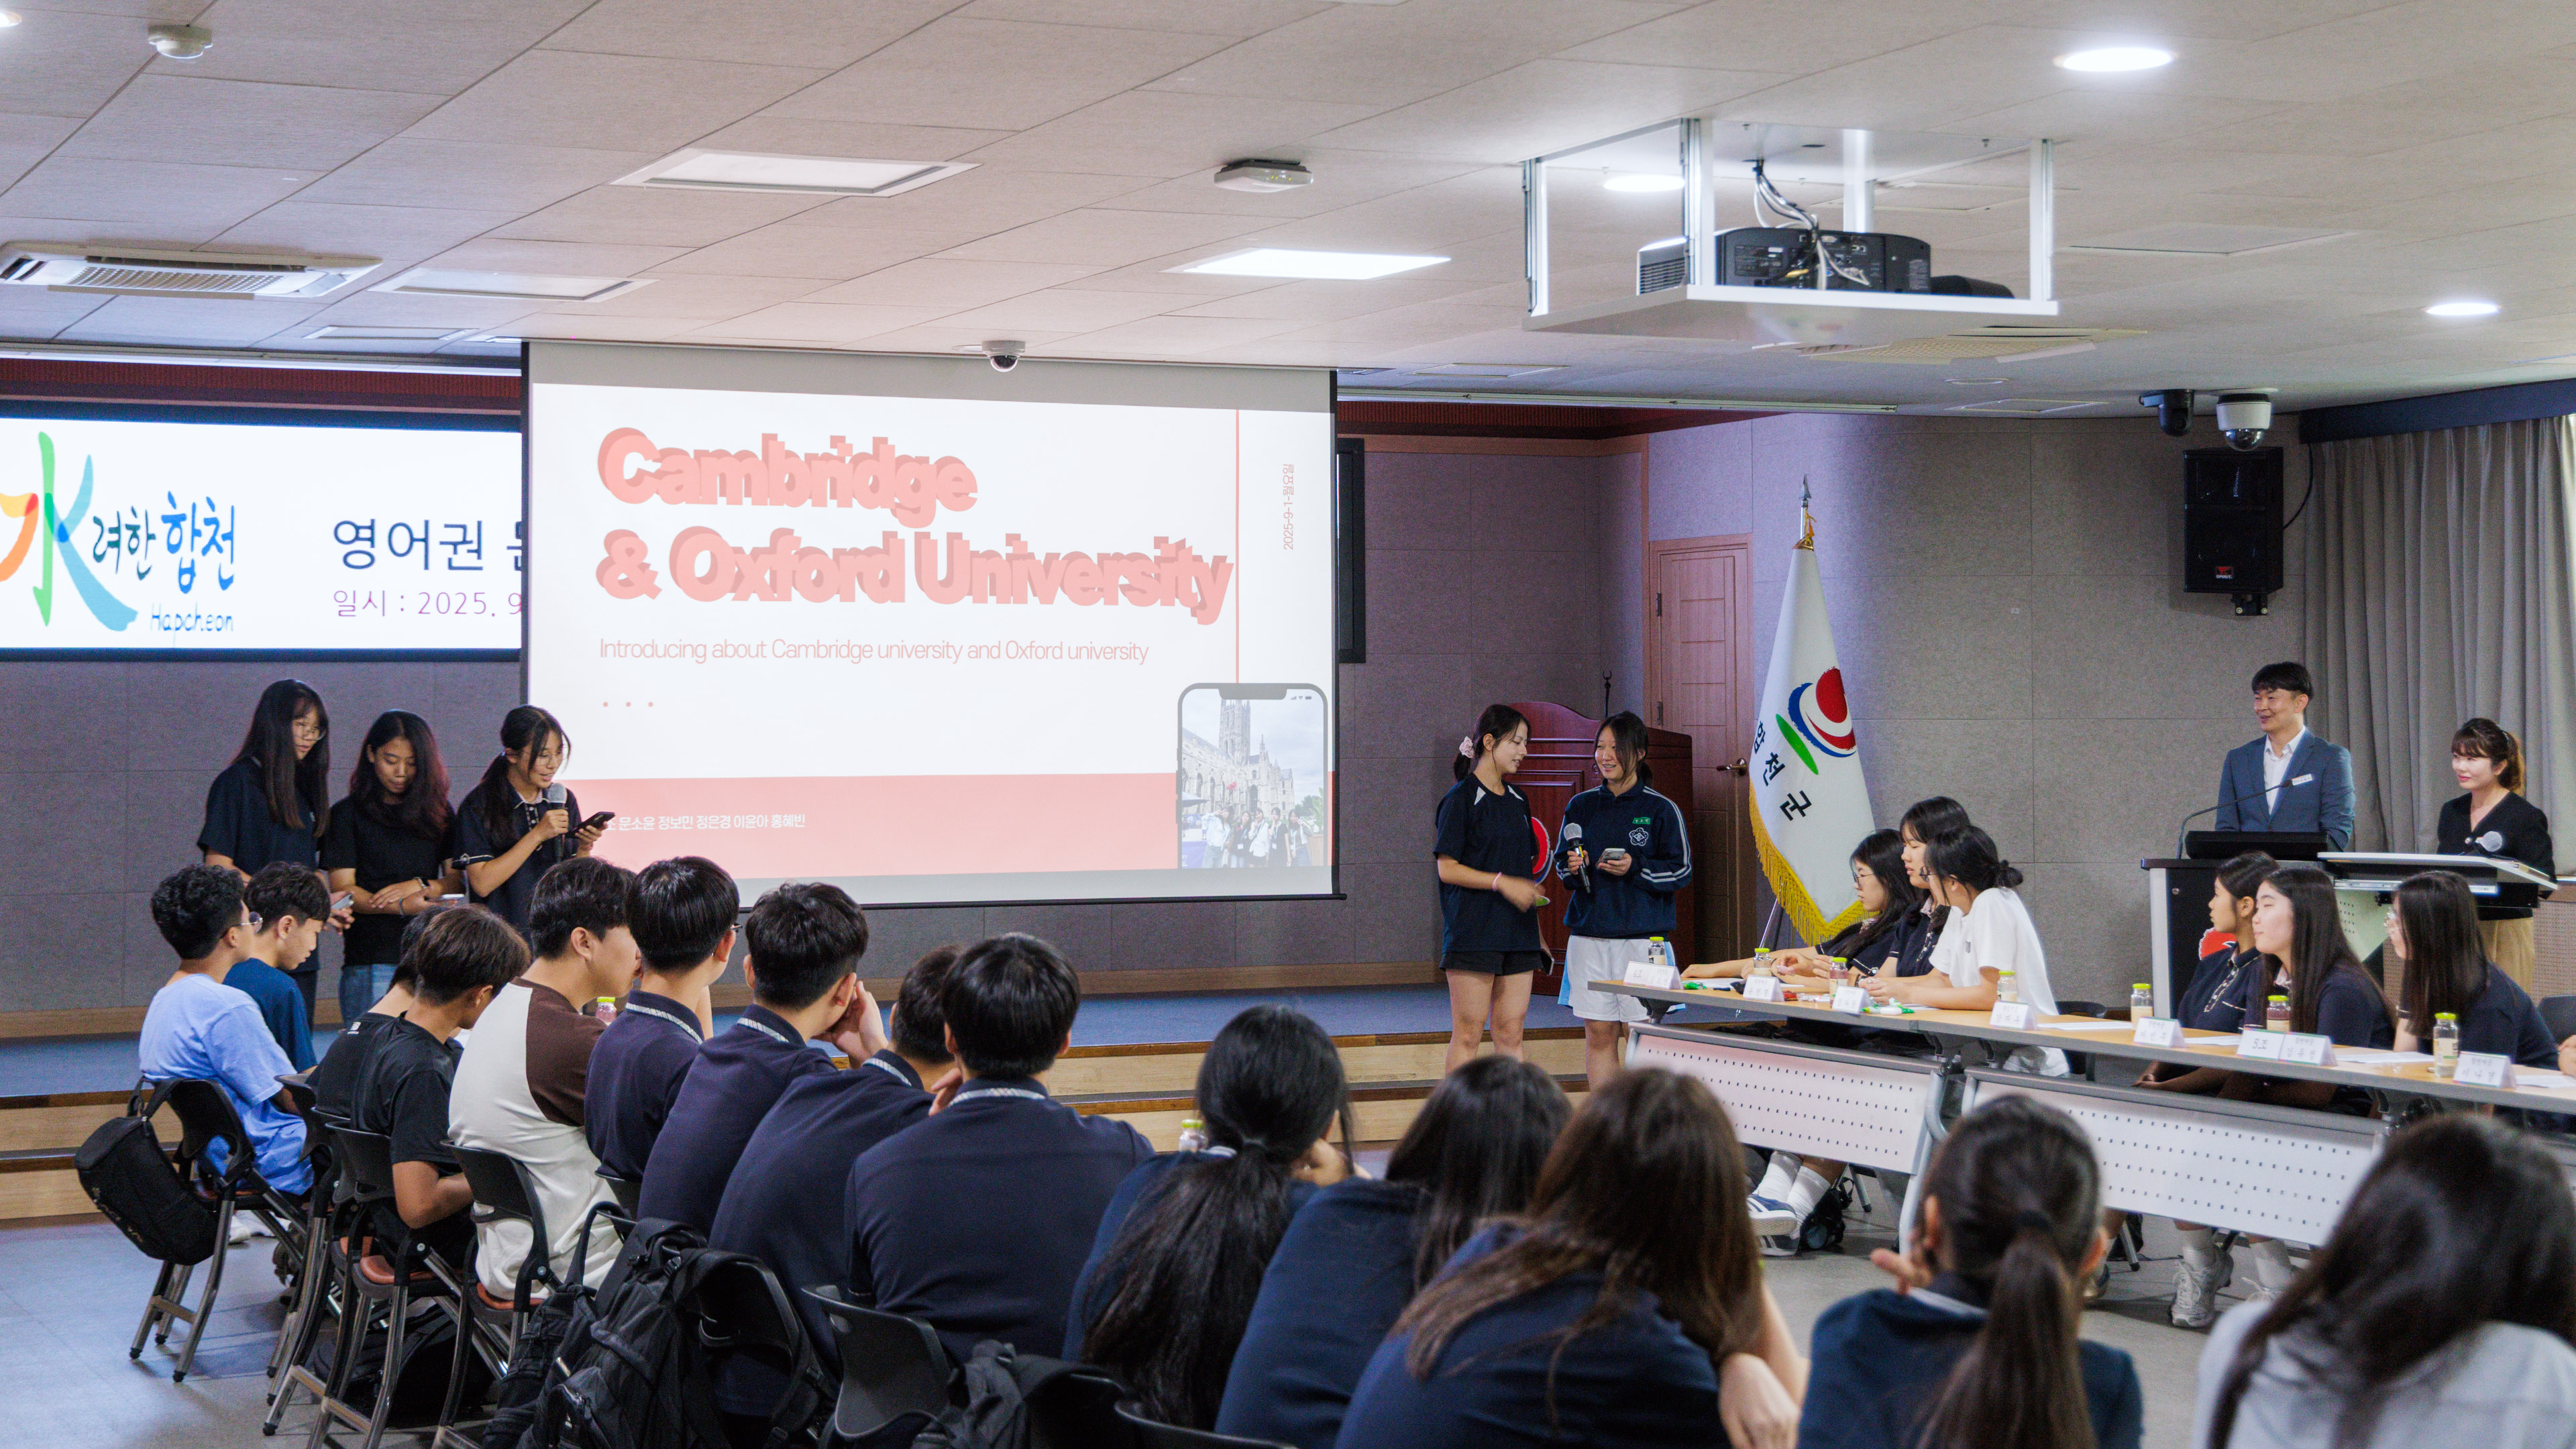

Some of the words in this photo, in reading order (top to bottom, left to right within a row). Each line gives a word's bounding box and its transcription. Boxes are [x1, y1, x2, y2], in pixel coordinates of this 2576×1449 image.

[598, 427, 977, 528] Cambridge
[161, 490, 234, 594] 합천
[333, 519, 483, 570] 영어권
[596, 529, 663, 600] &
[669, 526, 906, 604] Oxford
[914, 532, 1234, 626] University
[150, 602, 233, 643] Hapcheon
[333, 590, 385, 616] 일시
[418, 592, 495, 617] 2025.
[600, 639, 707, 664] Introducing
[712, 639, 767, 658] about
[772, 639, 873, 664] Cambridge
[877, 640, 963, 664] university
[967, 641, 1001, 659] and
[1006, 640, 1063, 660] Oxford
[1068, 641, 1149, 665] university
[619, 816, 655, 831] 문소윤
[658, 815, 694, 830] 정보민
[696, 815, 731, 830] 정은경
[733, 814, 769, 829] 이윤아
[771, 813, 806, 828] 홍혜빈
